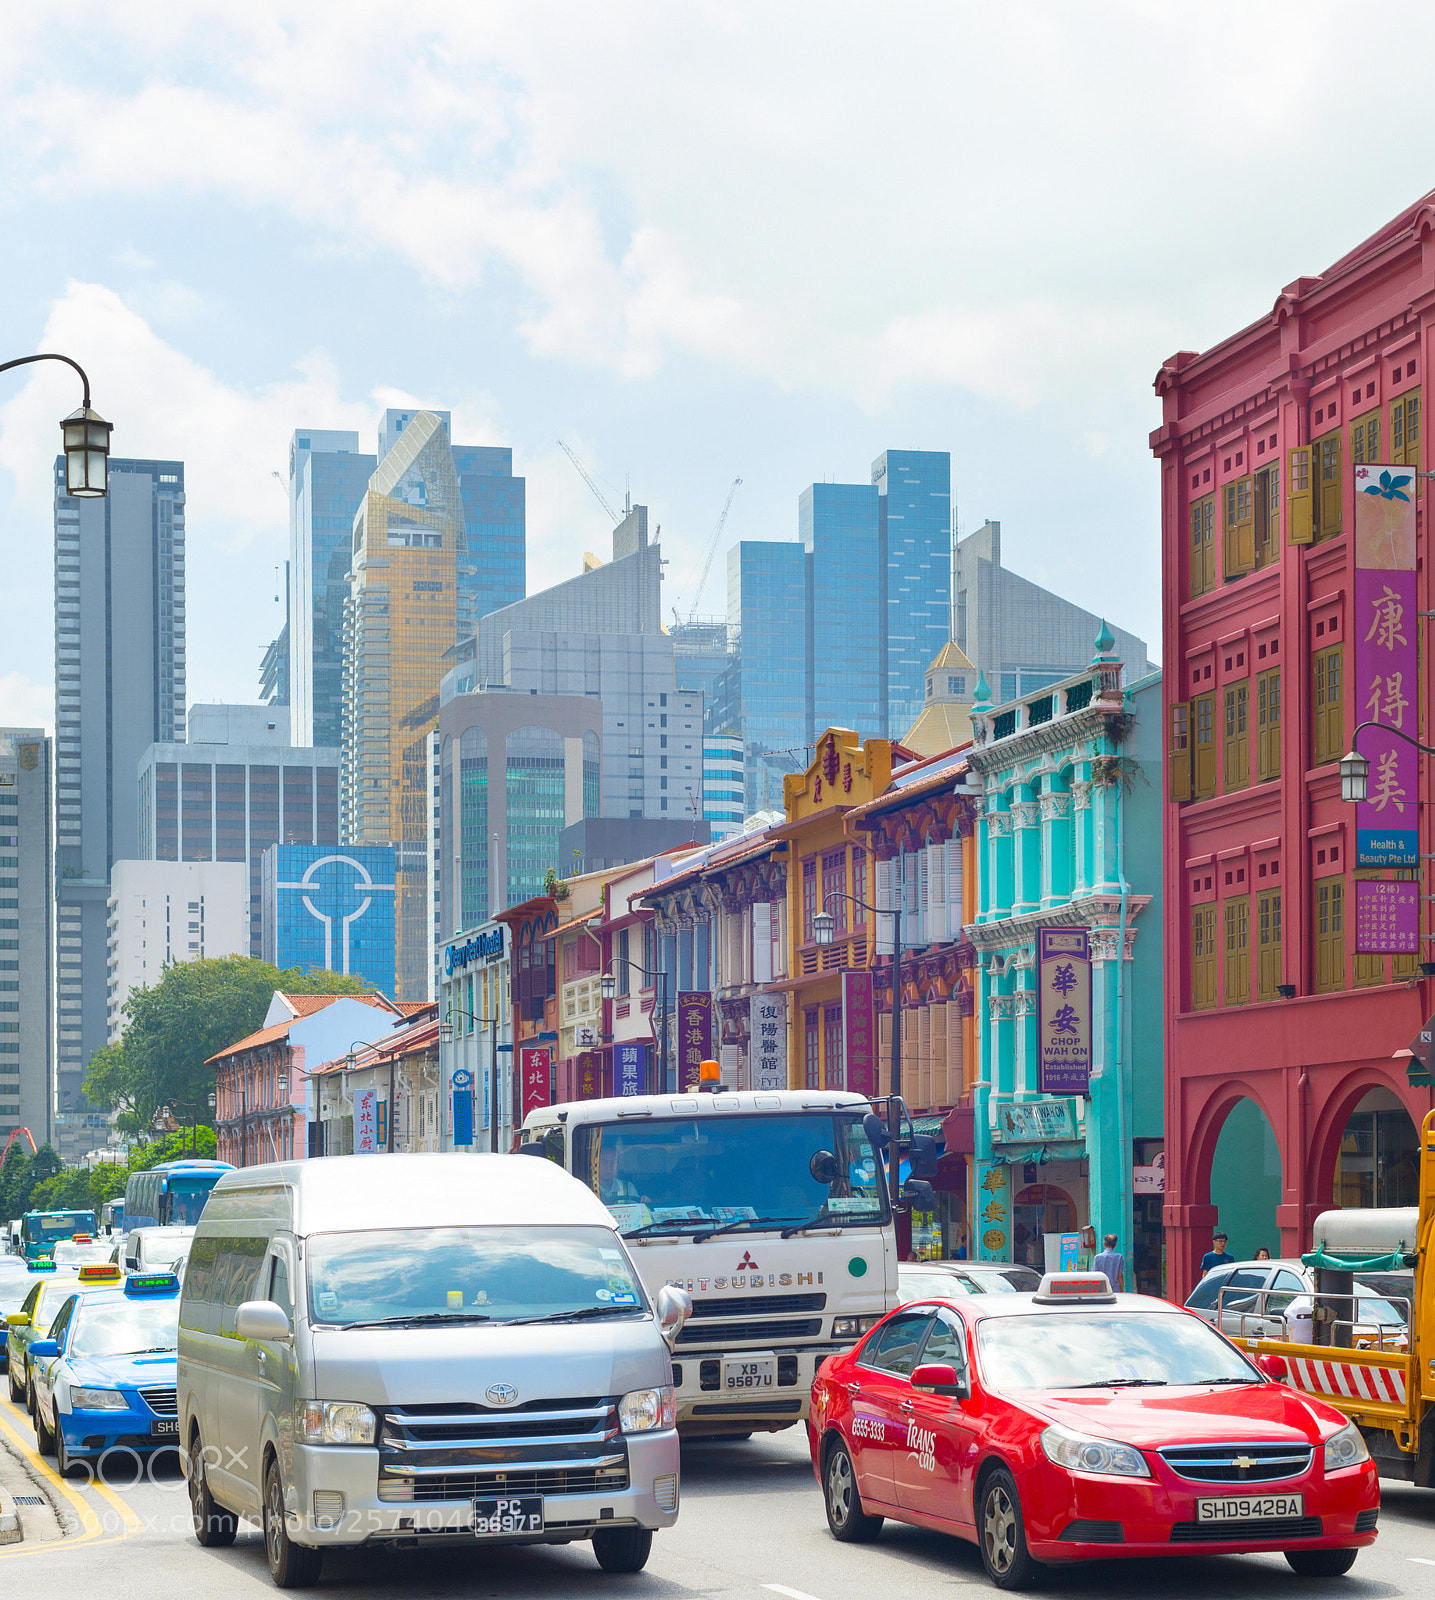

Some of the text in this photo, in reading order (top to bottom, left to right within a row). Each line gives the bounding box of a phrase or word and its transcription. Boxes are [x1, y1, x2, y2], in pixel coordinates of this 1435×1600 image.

[1364, 585, 1409, 814] 康得美
[1370, 840, 1405, 850] Health &
[1360, 853, 1416, 865] Beauty Pte Ltd
[1050, 962, 1081, 1034] 華安
[760, 1005, 778, 1071] 復陽醫館
[1050, 1037, 1081, 1046] CHOP
[1044, 1047, 1088, 1056] WAH ON
[761, 1077, 780, 1087] FYT
[981, 1168, 1007, 1223] 華安
[665, 1271, 824, 1292] MITSUBISHI
[741, 1364, 758, 1376] XB
[851, 1417, 885, 1442] 6555-3333
[906, 1418, 937, 1456] TRANS
[496, 1499, 522, 1516] PC
[1201, 1499, 1299, 1519] SHD9428A
